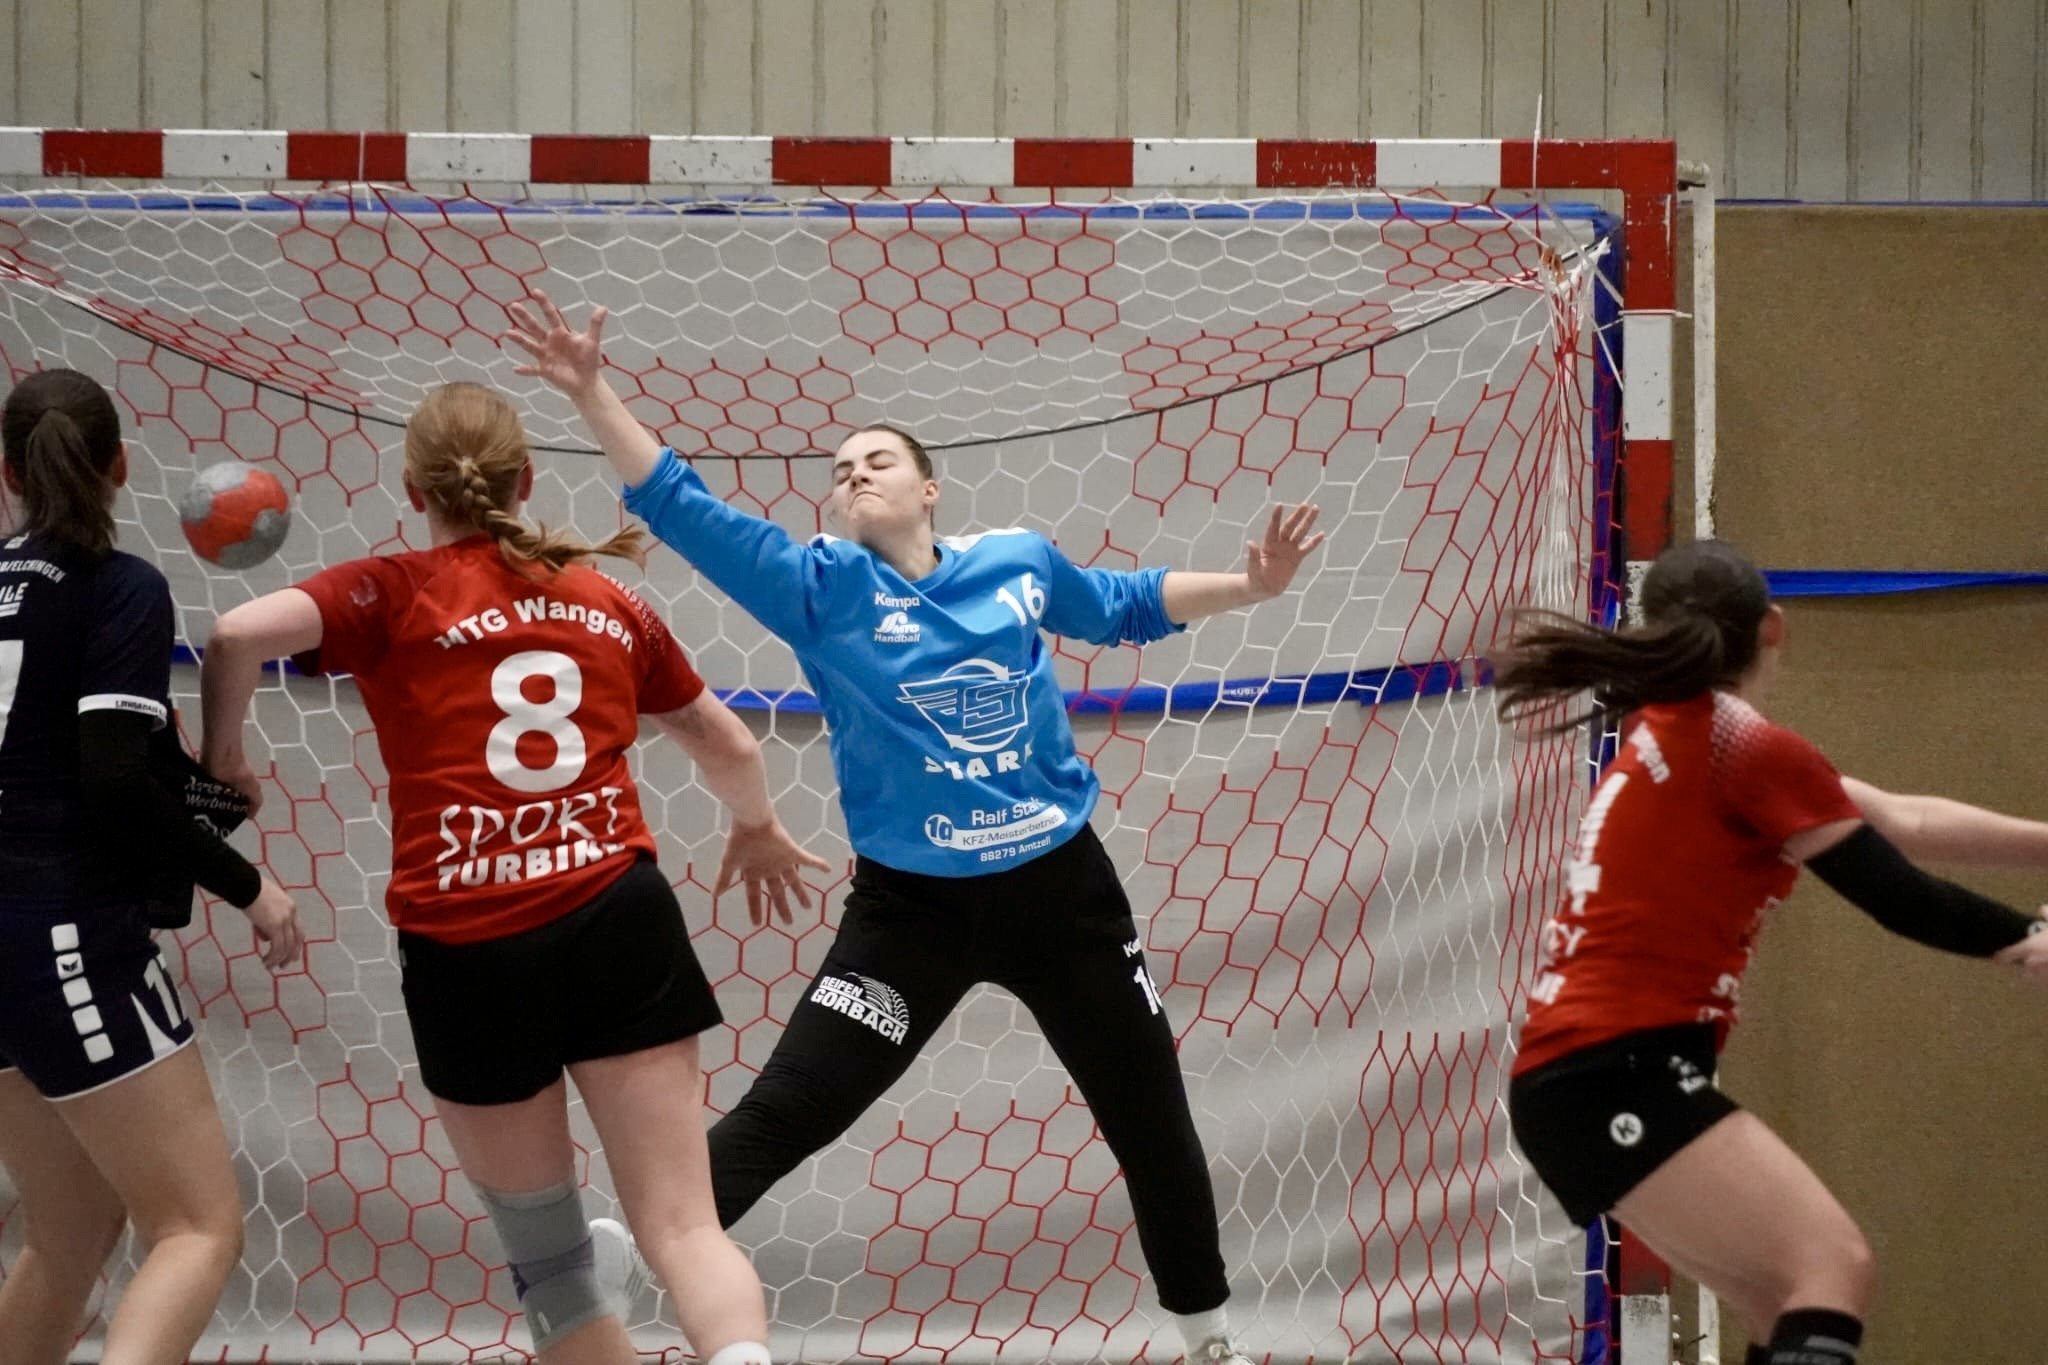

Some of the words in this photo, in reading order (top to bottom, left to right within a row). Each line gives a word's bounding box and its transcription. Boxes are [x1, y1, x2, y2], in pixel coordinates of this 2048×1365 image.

[874, 591, 920, 611] Kempa
[995, 572, 1046, 626] 16
[434, 607, 508, 649] MTG
[513, 596, 633, 652] Wangen
[874, 633, 920, 643] Handball
[485, 650, 587, 793] 8
[436, 786, 623, 863] SPORT
[971, 809, 1008, 827] Ralf
[980, 847, 1016, 863] 88279
[1018, 835, 1052, 854] Amtzell
[819, 975, 864, 998] REIFEN
[810, 988, 908, 1046] GORBACH
